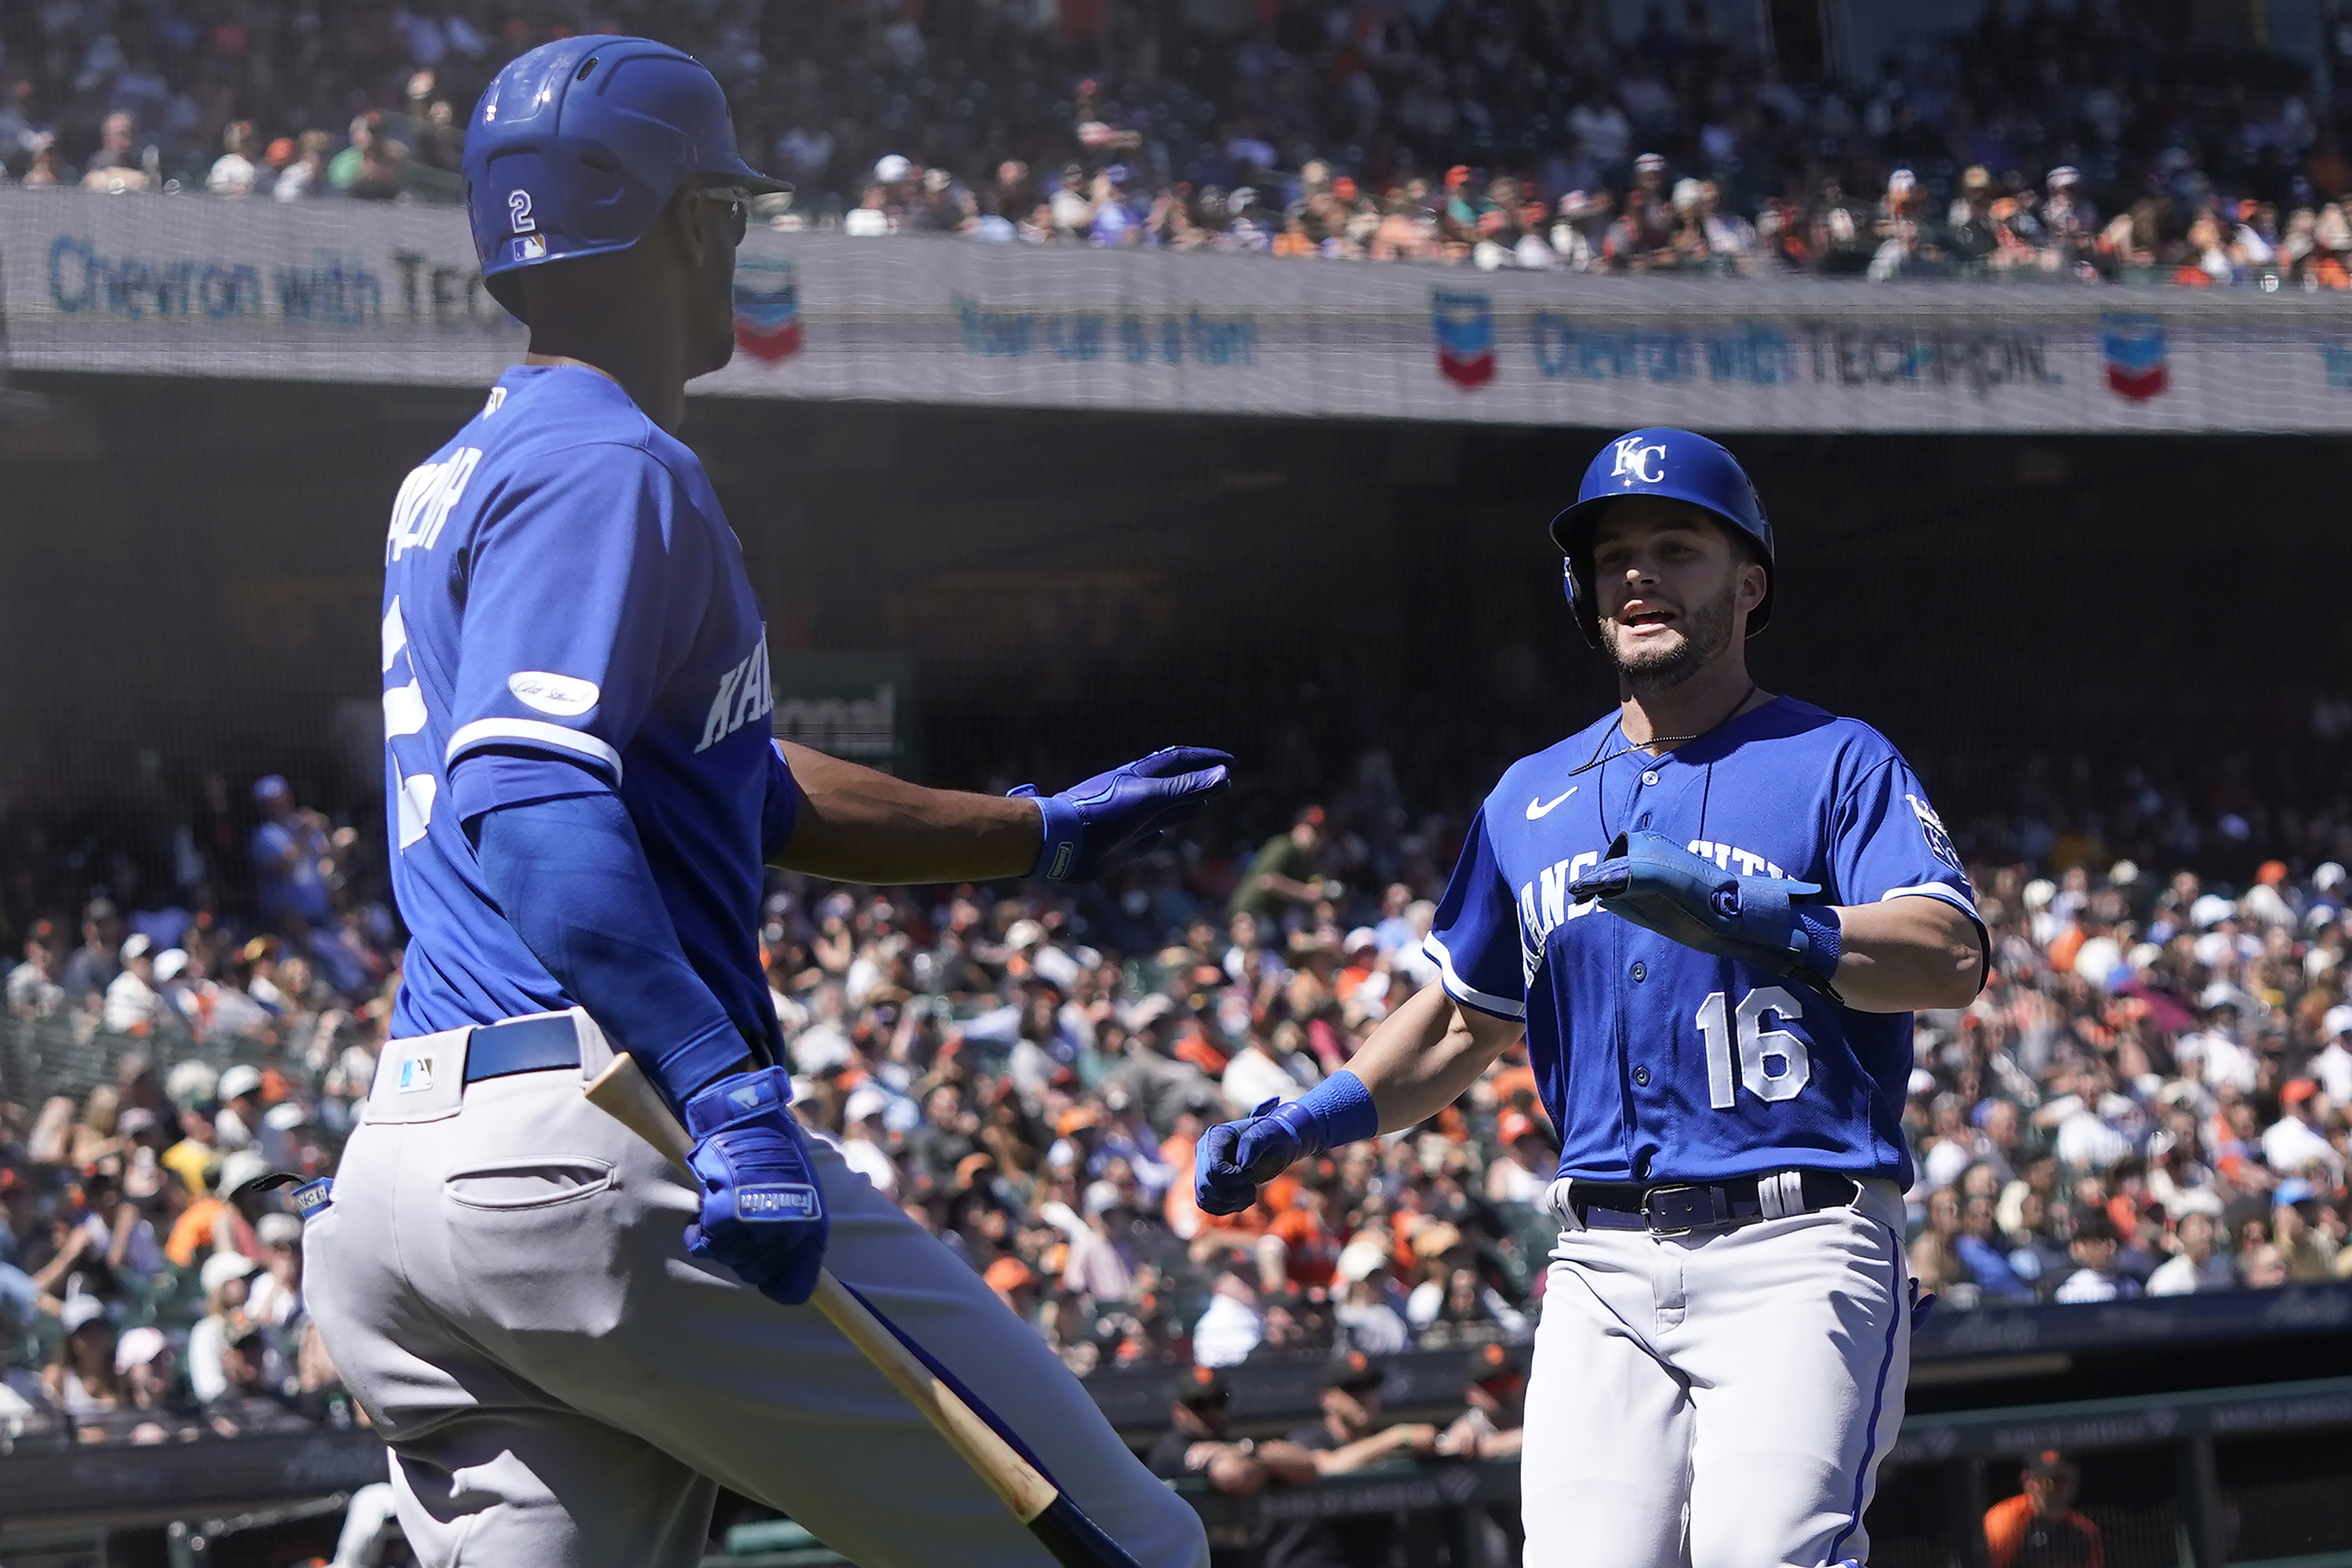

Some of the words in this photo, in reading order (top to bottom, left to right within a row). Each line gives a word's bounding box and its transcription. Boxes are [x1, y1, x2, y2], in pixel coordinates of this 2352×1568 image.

[508, 189, 536, 234] 2
[49, 234, 263, 320] Chevron
[1610, 436, 1667, 484] KC
[1695, 985, 1810, 1109] 16
